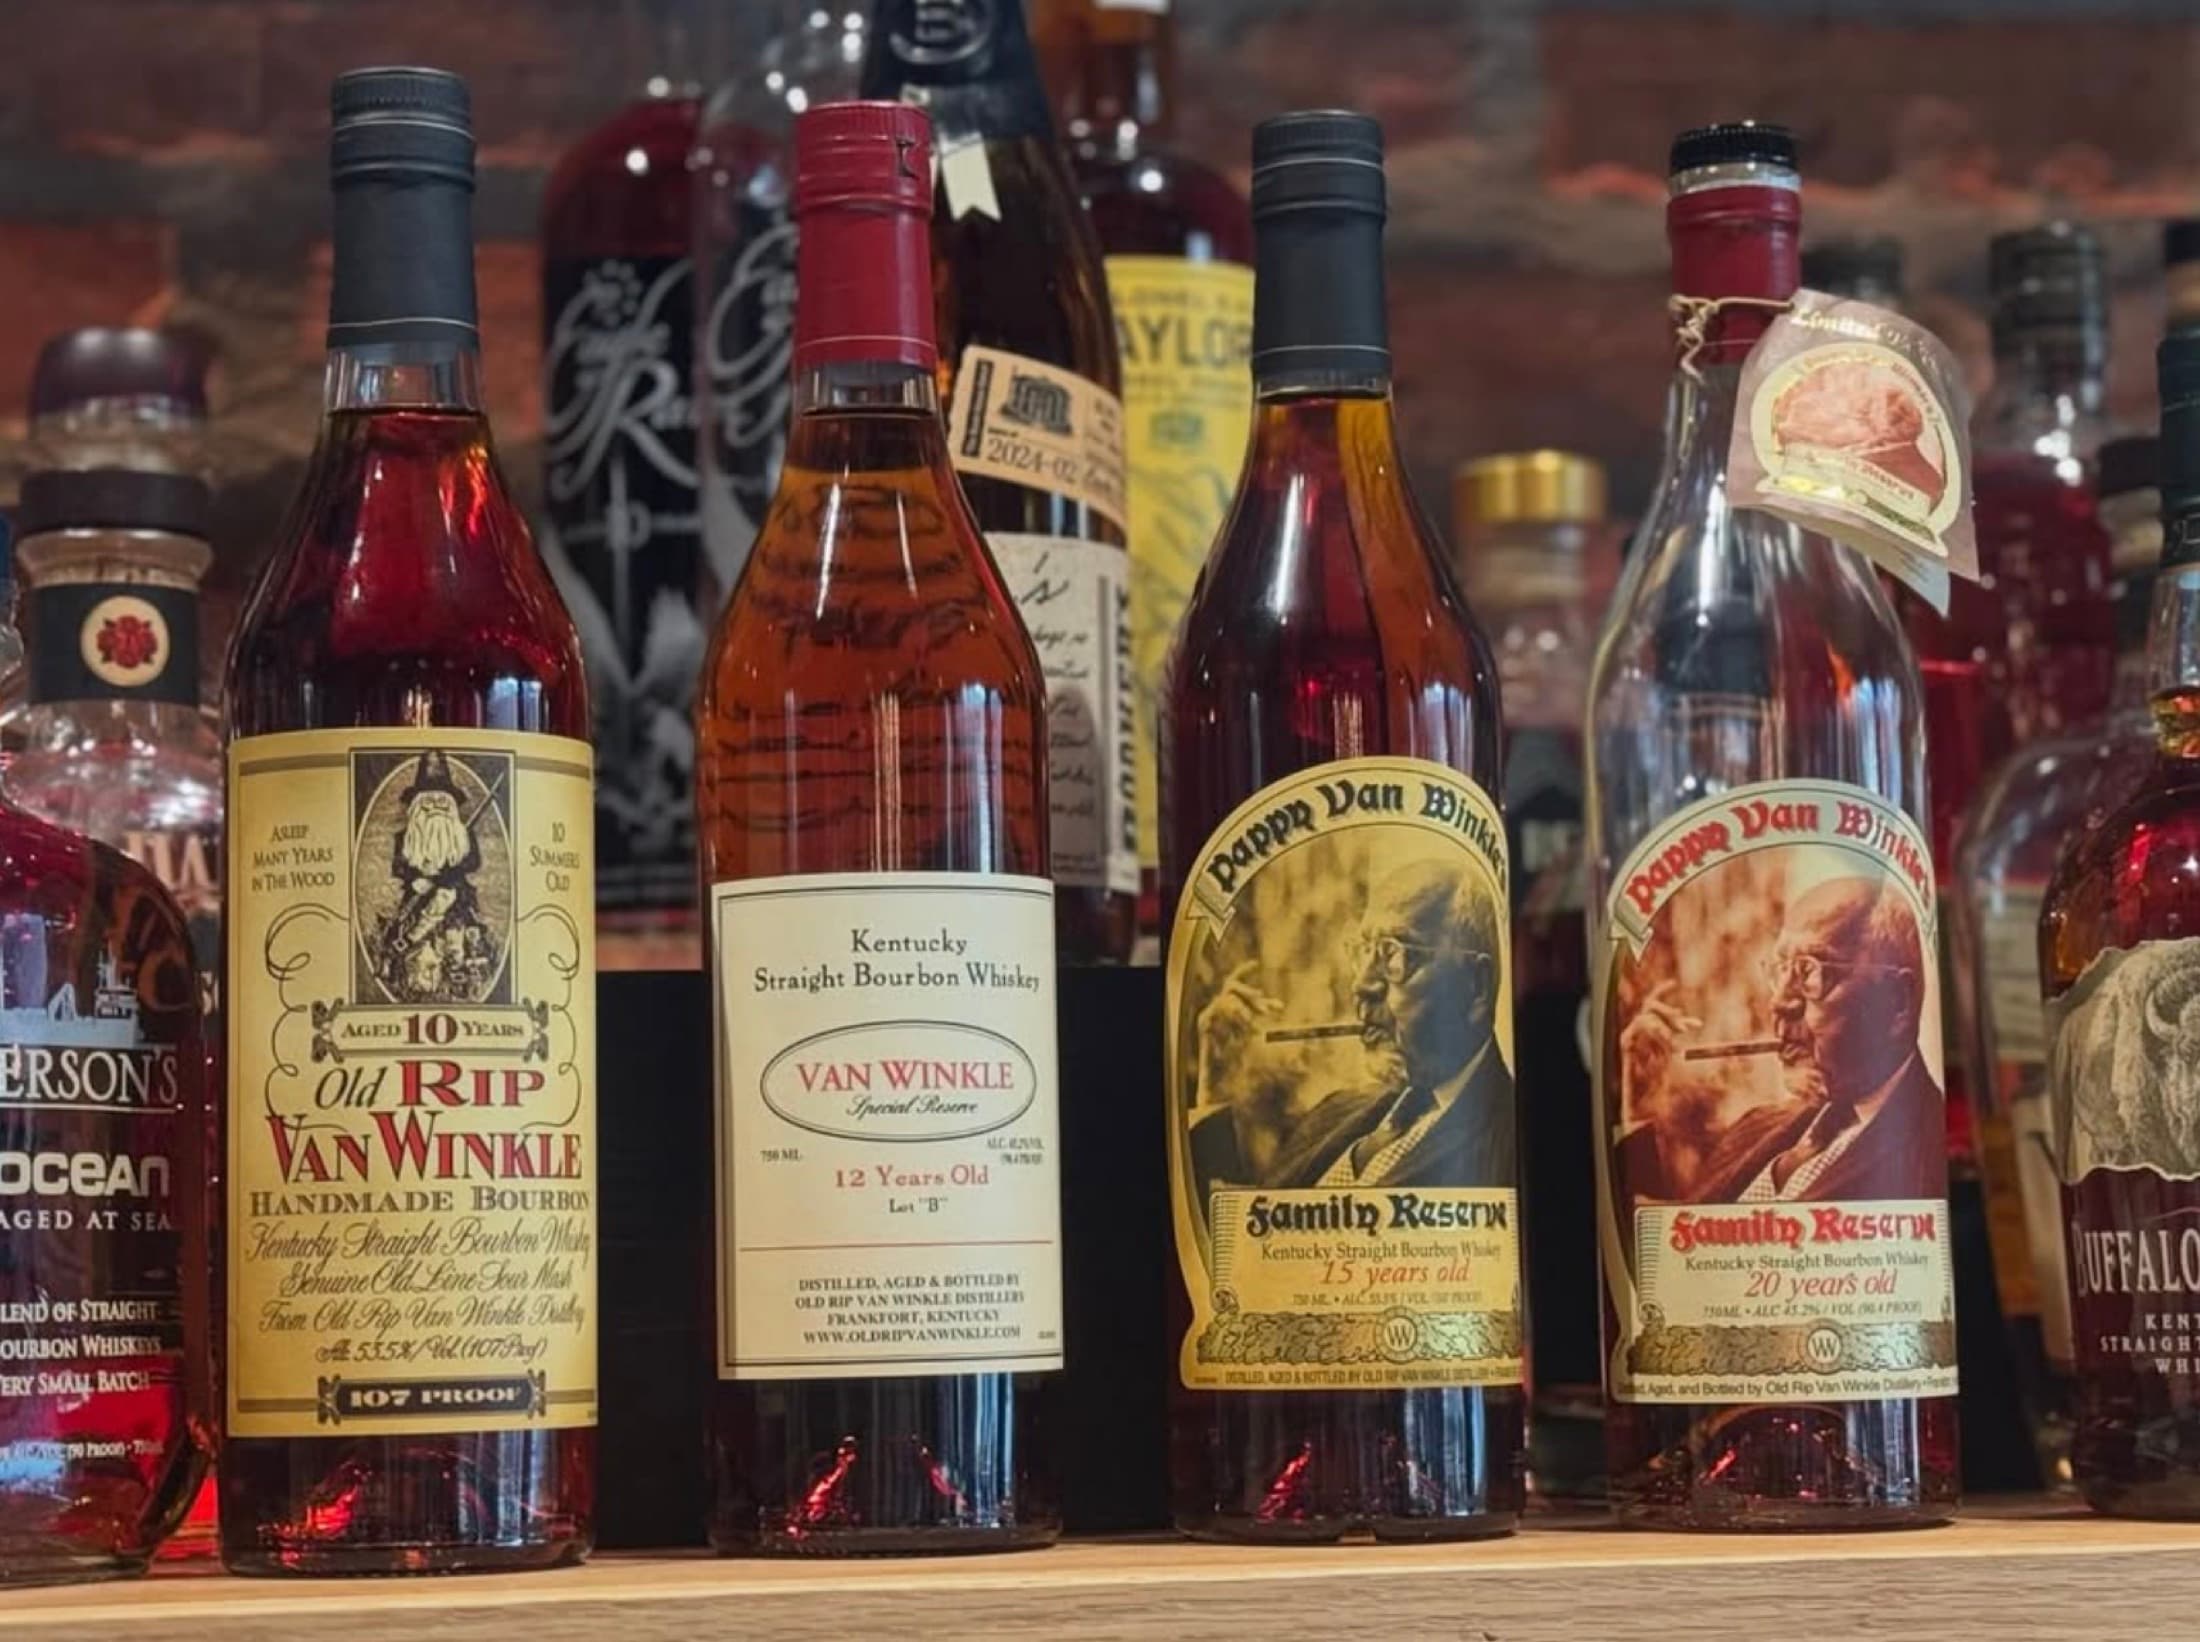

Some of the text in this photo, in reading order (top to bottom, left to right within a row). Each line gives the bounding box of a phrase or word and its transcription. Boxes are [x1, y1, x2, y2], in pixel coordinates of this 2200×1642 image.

[1207, 799, 1317, 893] Pappy
[1316, 780, 1404, 818] Van
[1626, 821, 1733, 914] Pappy
[1731, 800, 1820, 839] Van
[290, 870, 335, 889] WOOD
[851, 929, 968, 955] Kentucky
[753, 962, 1040, 994] Straight Bourbon Whiskey
[341, 1013, 524, 1045] AGED 10 YEARS
[314, 1059, 546, 1111] Old RIP
[797, 1059, 1015, 1093] VAN WINKLE
[846, 1093, 979, 1123] Special Reserve
[264, 1106, 582, 1184] VAN WINKLE
[834, 1163, 990, 1188] 12 Years Old
[250, 1186, 591, 1218] HANDMADE BOURBON
[889, 1197, 915, 1213] Lot
[1247, 1192, 1381, 1238] Family
[86, 1209, 118, 1231] AT
[130, 1209, 172, 1232] SEA
[1670, 1207, 1807, 1254] Family
[245, 1219, 339, 1272] Kentucky
[341, 1217, 443, 1264] Straight
[440, 1216, 539, 1256] Bourbon
[1261, 1243, 1332, 1263] Kentucky
[1334, 1242, 1398, 1263] Straight
[1400, 1241, 1457, 1258] Bourbon
[1685, 1256, 1757, 1274] Kentucky
[1758, 1254, 1820, 1274] Straight
[1823, 1254, 1883, 1269] Bourbon
[2071, 1219, 2200, 1298] BUFFALO
[798, 1277, 880, 1292] DISTILLED,
[882, 1276, 926, 1289] AGED
[928, 1275, 939, 1288] &
[943, 1273, 1003, 1288] BOTTLED
[1318, 1259, 1471, 1295] 15 years old
[1743, 1268, 1899, 1304] 20 years old
[52, 1299, 78, 1322] OF
[80, 1298, 157, 1321] STRAIGHT
[794, 1296, 826, 1310] OLD
[828, 1295, 854, 1309] RIP
[855, 1293, 890, 1308] VAN
[891, 1292, 952, 1306] WINKLE
[825, 1308, 1000, 1327] FRANKFORT, KENTUCKY
[802, 1325, 1021, 1345] WWW.OLDRIPVANWINKLE.COM
[98, 1370, 150, 1392] BATCH
[1765, 1380, 1789, 1394] Old
[1815, 1379, 1840, 1393] Van
[350, 1386, 522, 1409] 107 PROOF
